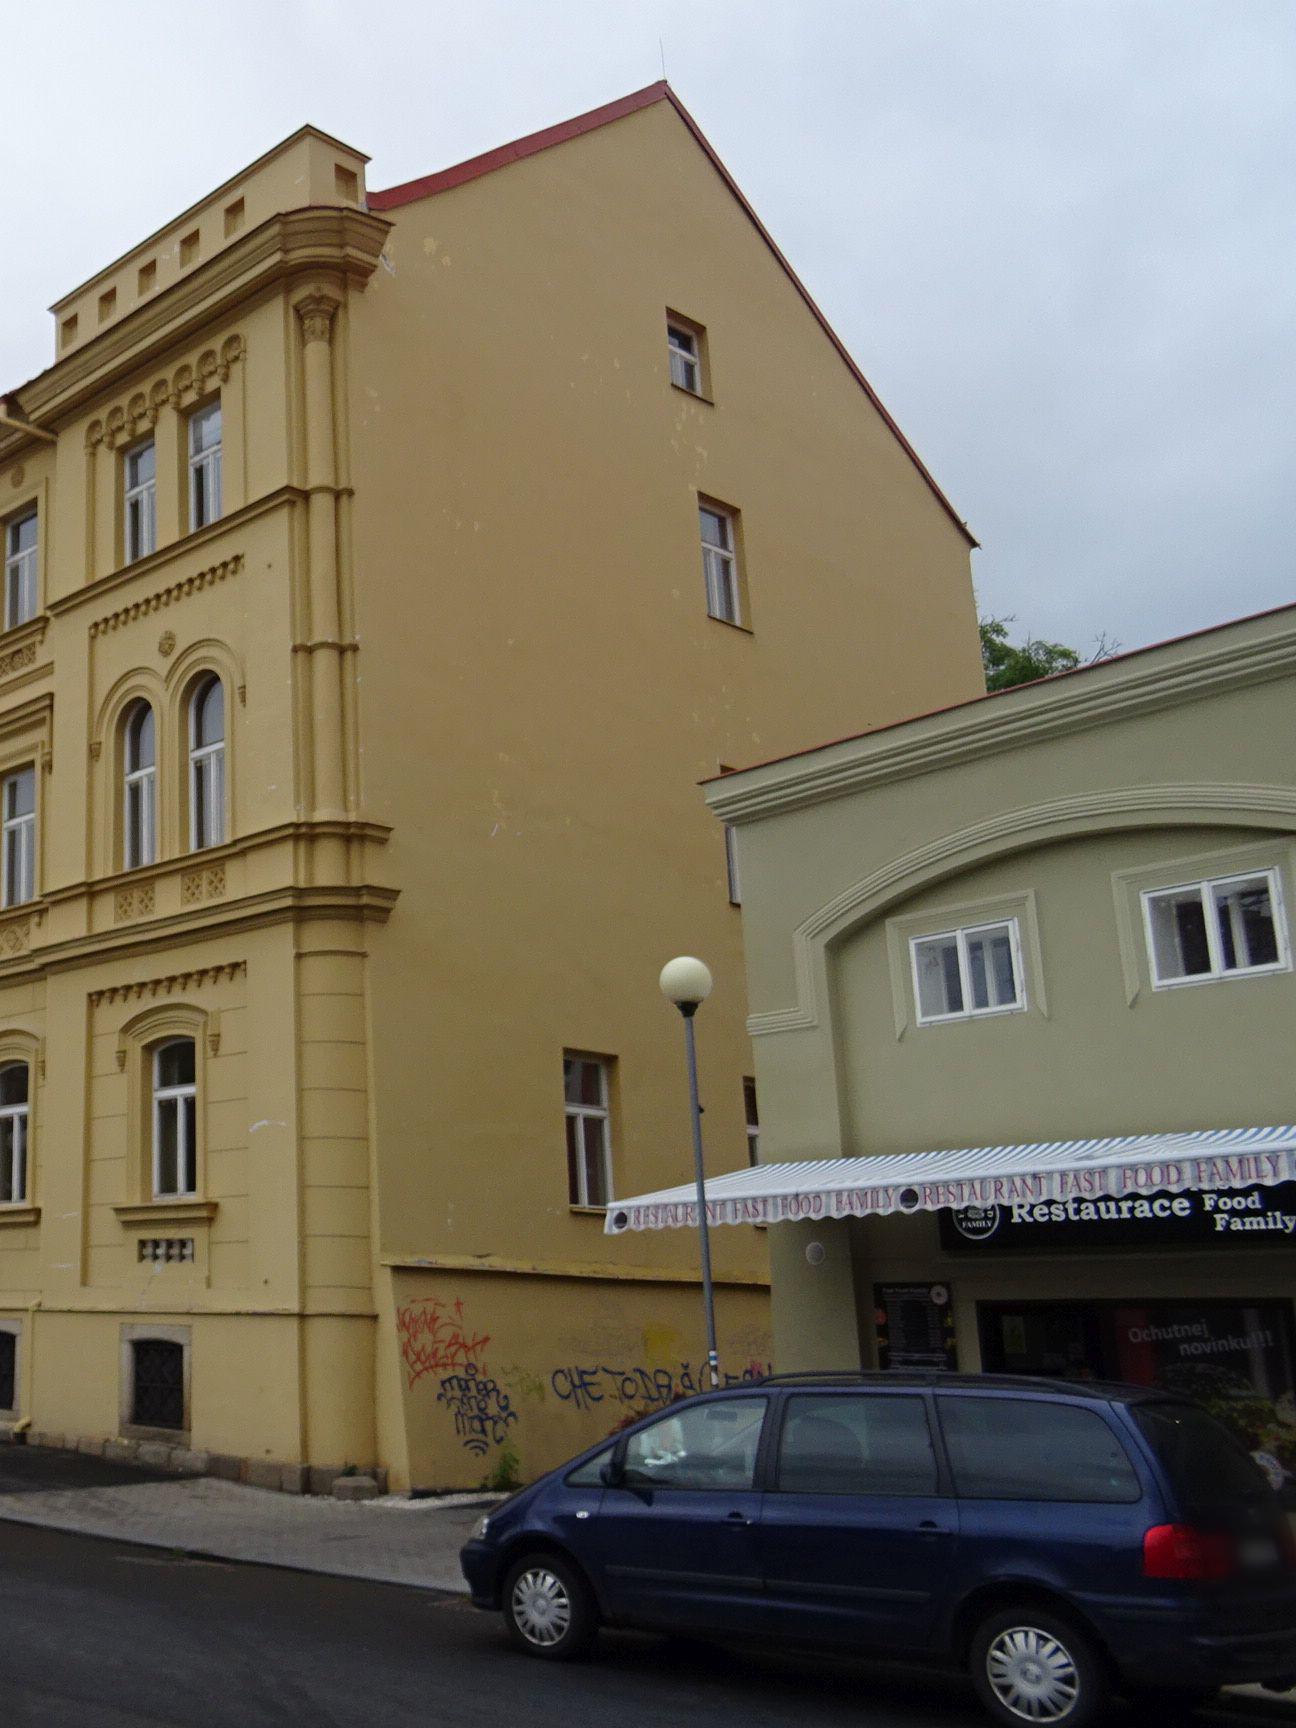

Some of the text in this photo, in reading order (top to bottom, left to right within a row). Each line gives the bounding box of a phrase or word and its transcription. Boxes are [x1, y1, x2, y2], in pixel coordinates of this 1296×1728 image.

[923, 1153, 1281, 1206] RESTAURANT FAST FOOD FAMILY
[633, 1187, 895, 1226] RESTAURNT FAST FOOD FAMILY
[1011, 1197, 1191, 1224] Restaurace
[1202, 1191, 1262, 1211] Food
[1213, 1212, 1296, 1234] Family
